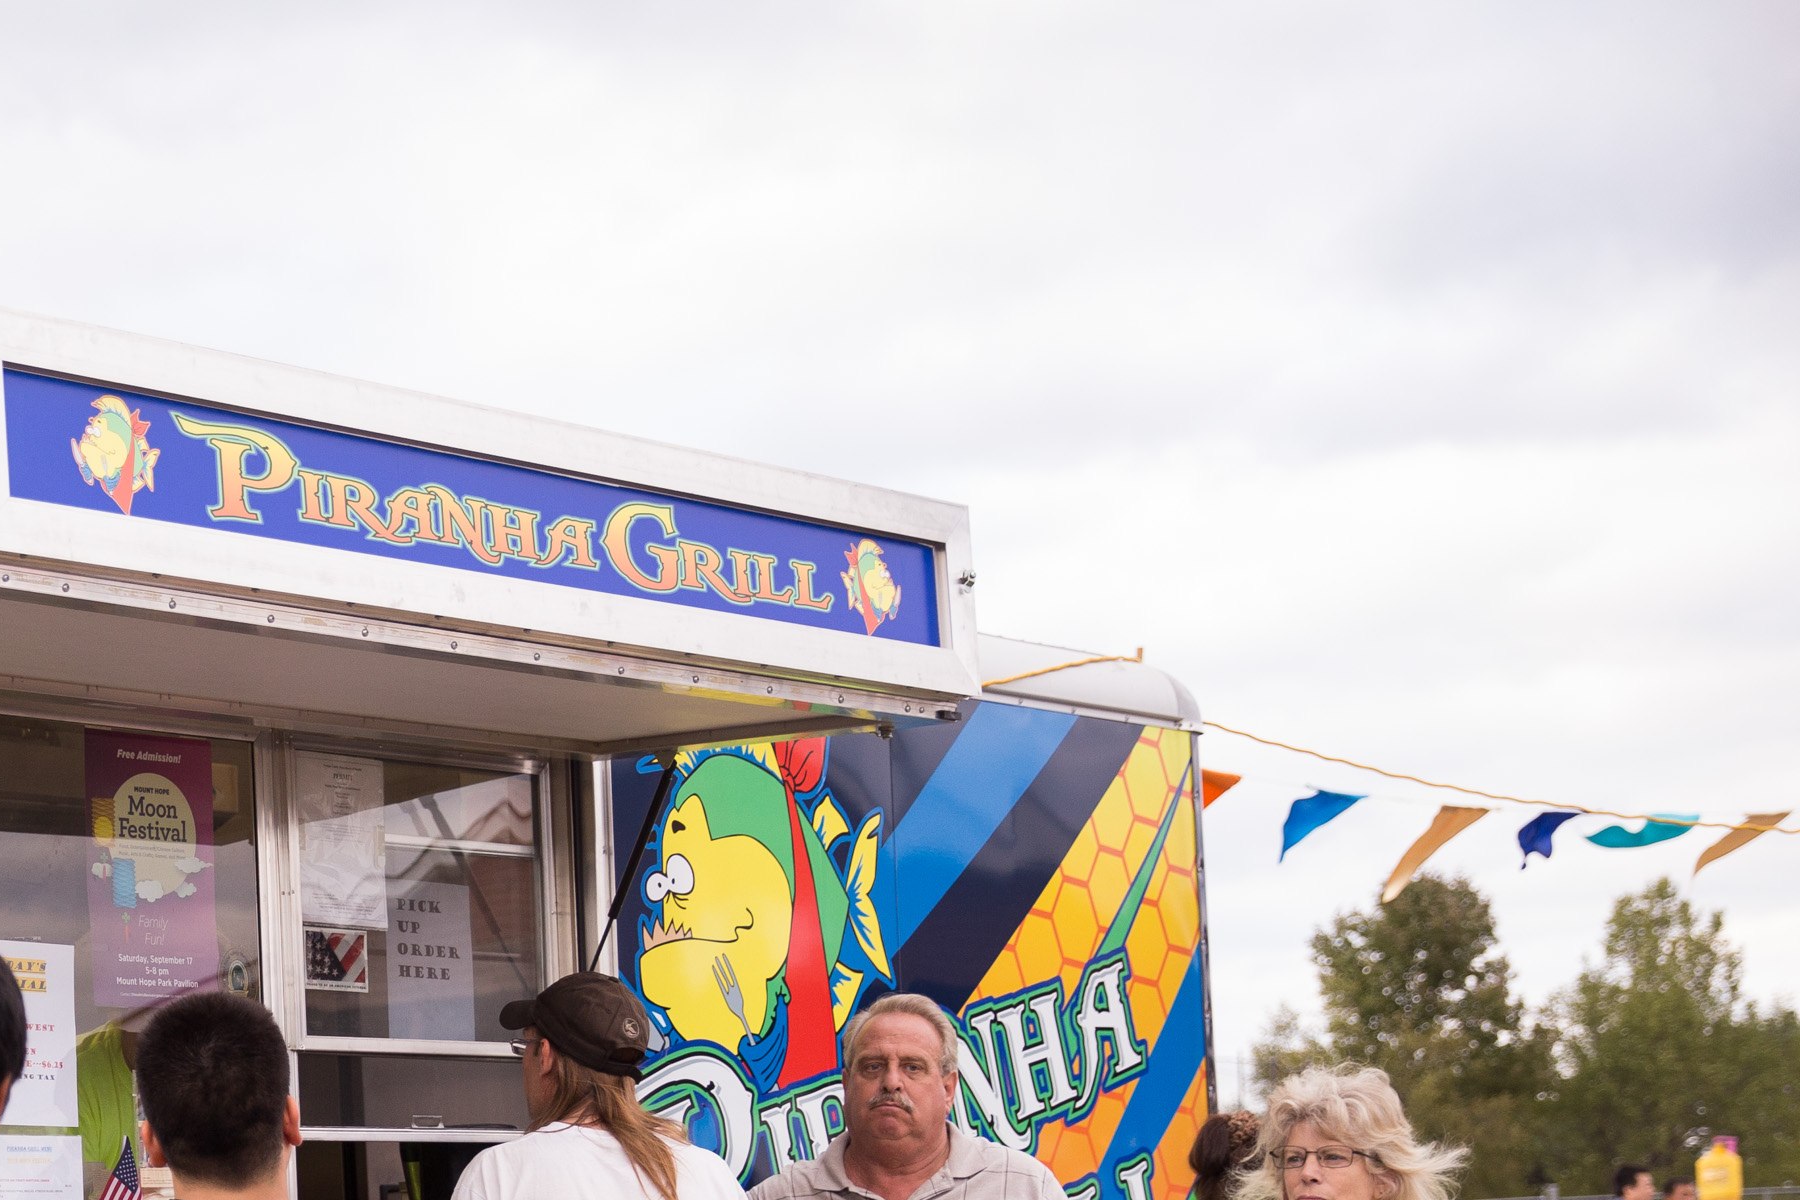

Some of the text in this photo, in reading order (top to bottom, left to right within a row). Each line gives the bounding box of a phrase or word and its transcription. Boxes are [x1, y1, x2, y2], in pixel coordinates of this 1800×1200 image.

[170, 410, 835, 612] PIRANHA GRILL
[117, 749, 181, 764] Free Admission!
[134, 786, 154, 794] MOUNT
[128, 795, 178, 819] Moon
[119, 818, 187, 843] Festival
[396, 898, 441, 913] PICK
[139, 915, 169, 931] Family
[397, 920, 420, 933] UP
[145, 933, 165, 946] Fun!
[398, 943, 460, 959] ORDER
[118, 954, 193, 965] Saturday, September 17
[145, 967, 169, 976] 5-8 pm
[399, 965, 450, 980] HERE
[116, 977, 199, 988] Mount Hope Park Pavilion
